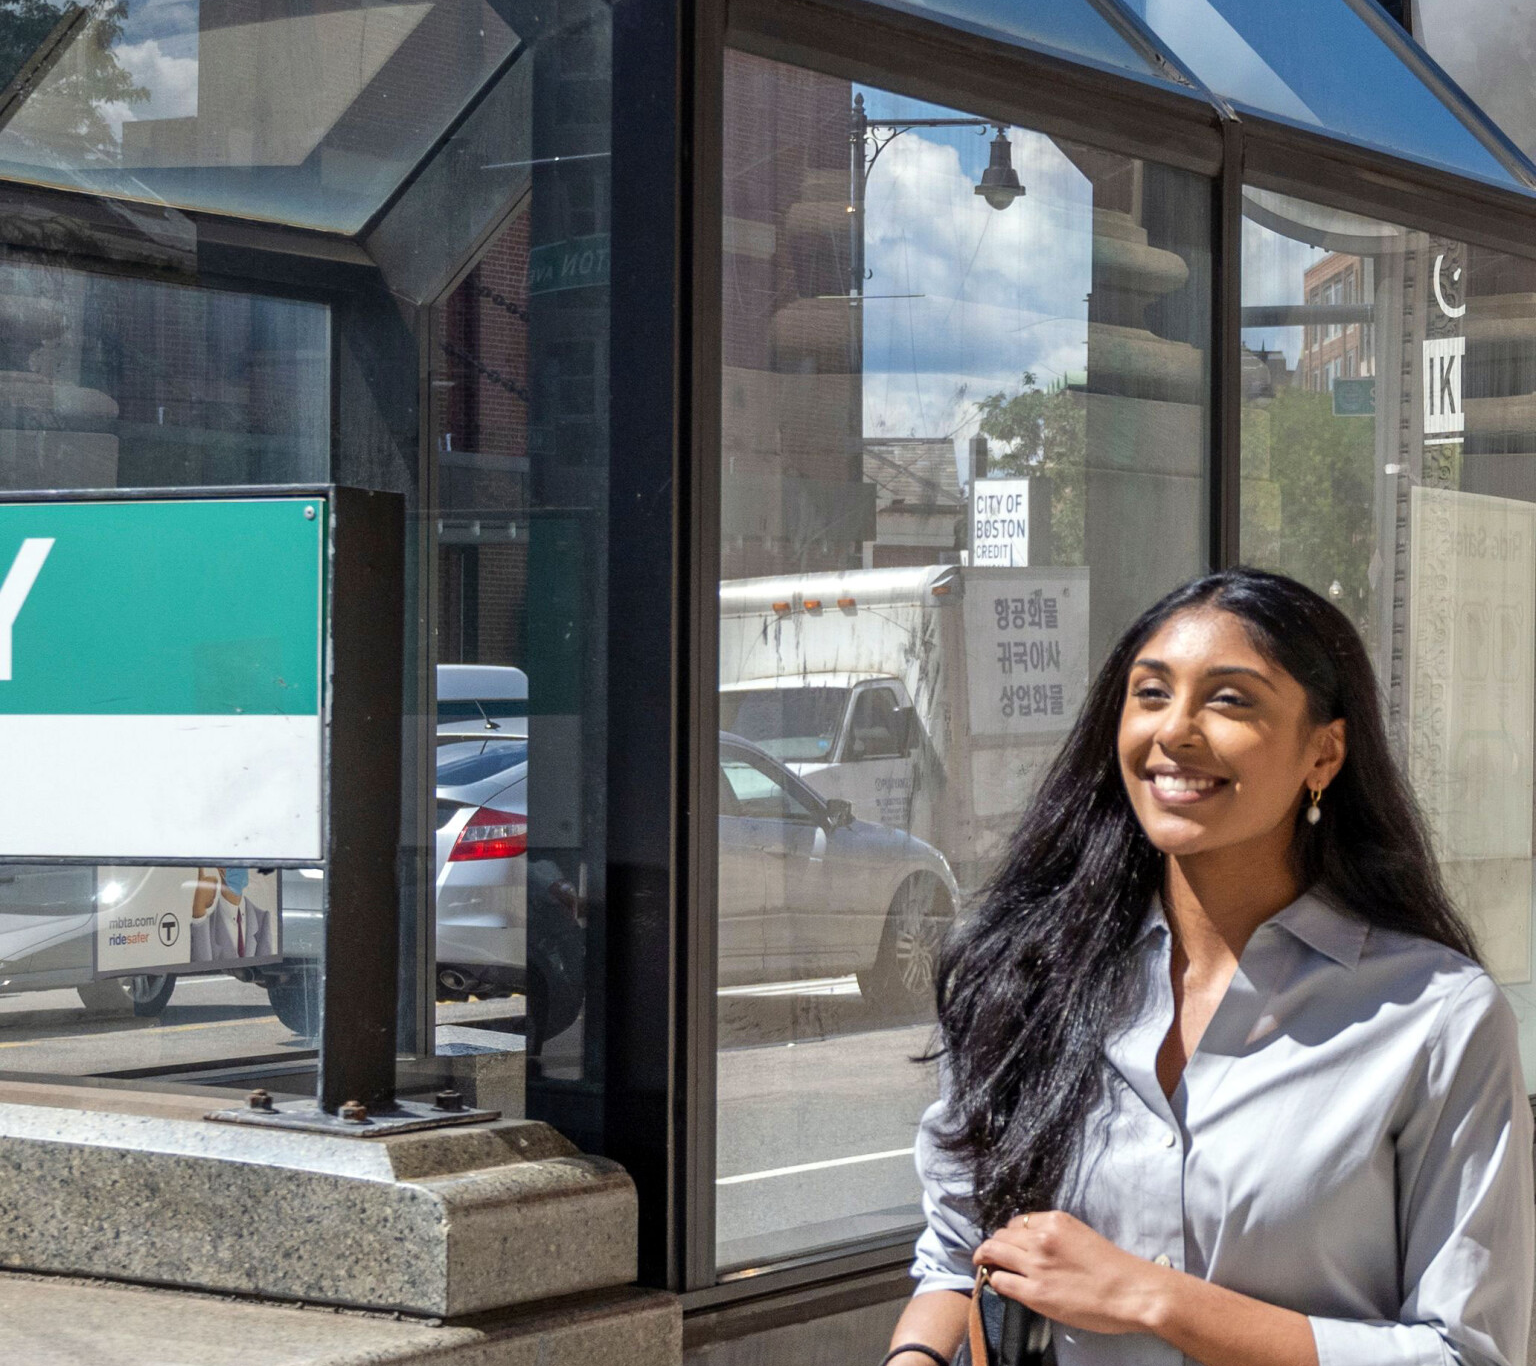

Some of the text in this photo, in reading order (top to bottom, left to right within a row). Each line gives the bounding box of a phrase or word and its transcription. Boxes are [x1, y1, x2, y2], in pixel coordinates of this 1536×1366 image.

[976, 494, 1022, 515] CITY OF
[976, 519, 1026, 540] BOSTON
[975, 544, 1008, 559] CREDIT
[994, 597, 1058, 631] 항공화물
[997, 640, 1061, 674] 귀국이사
[999, 684, 1064, 718] 상업화물
[109, 913, 158, 930] mbta.com/
[109, 932, 150, 946] ridesafer
